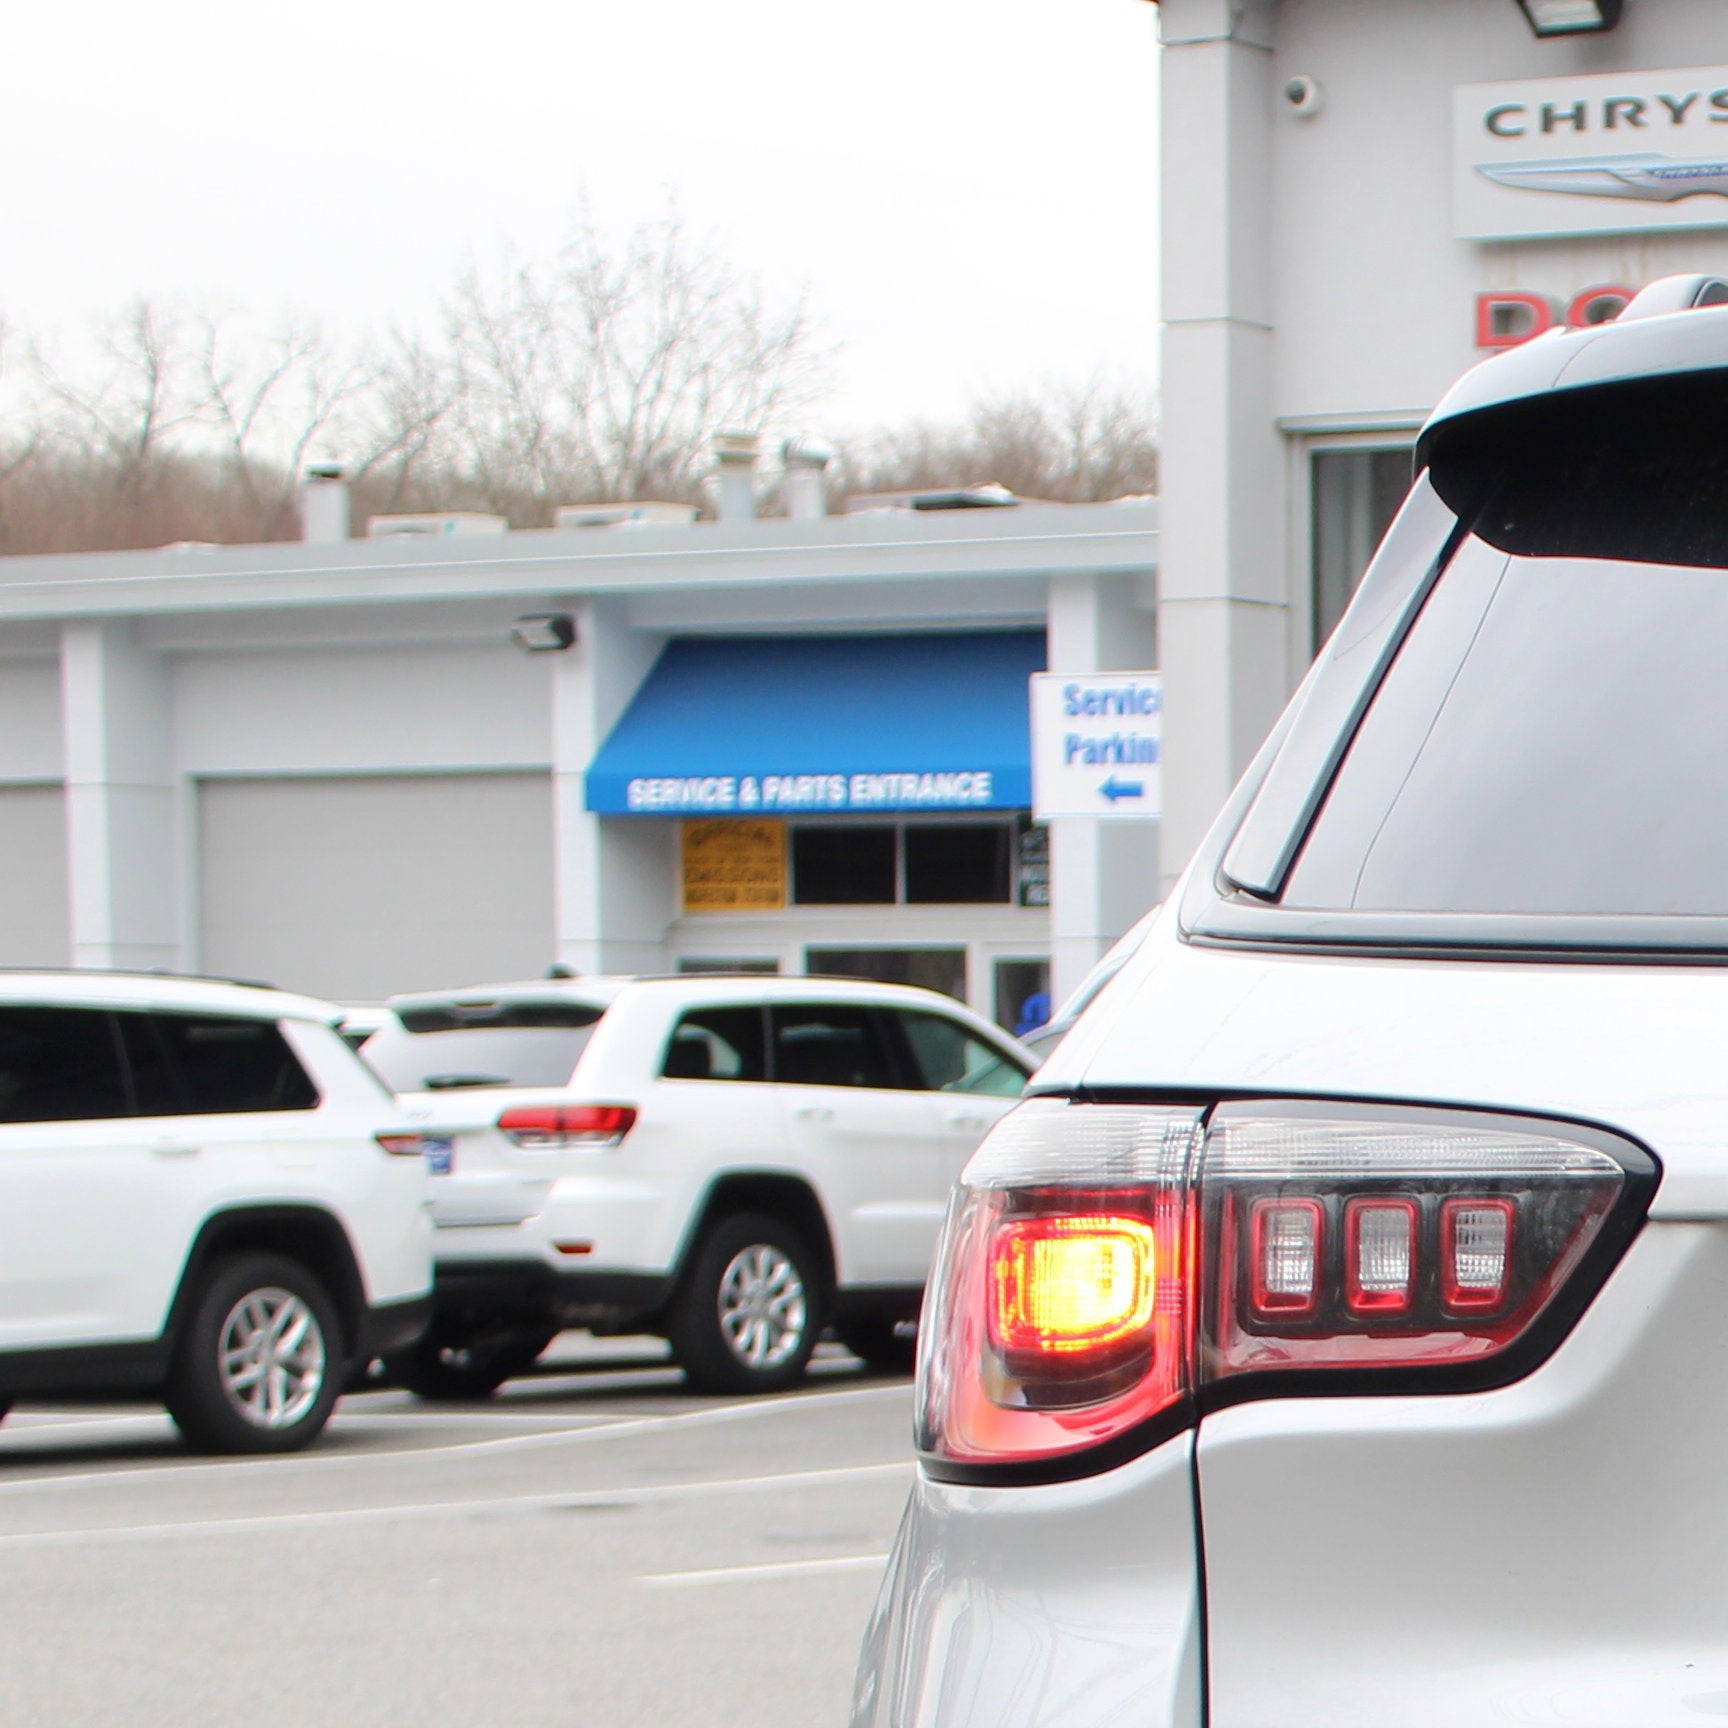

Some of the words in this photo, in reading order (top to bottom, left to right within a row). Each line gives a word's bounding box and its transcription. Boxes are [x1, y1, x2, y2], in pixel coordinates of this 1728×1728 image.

[1062, 682, 1162, 716] Servic
[1062, 732, 1161, 765] Parkin
[628, 776, 737, 811] SERVICE
[739, 775, 760, 810] &
[761, 774, 848, 809] PARTS
[850, 771, 994, 807] ENTRANCE
